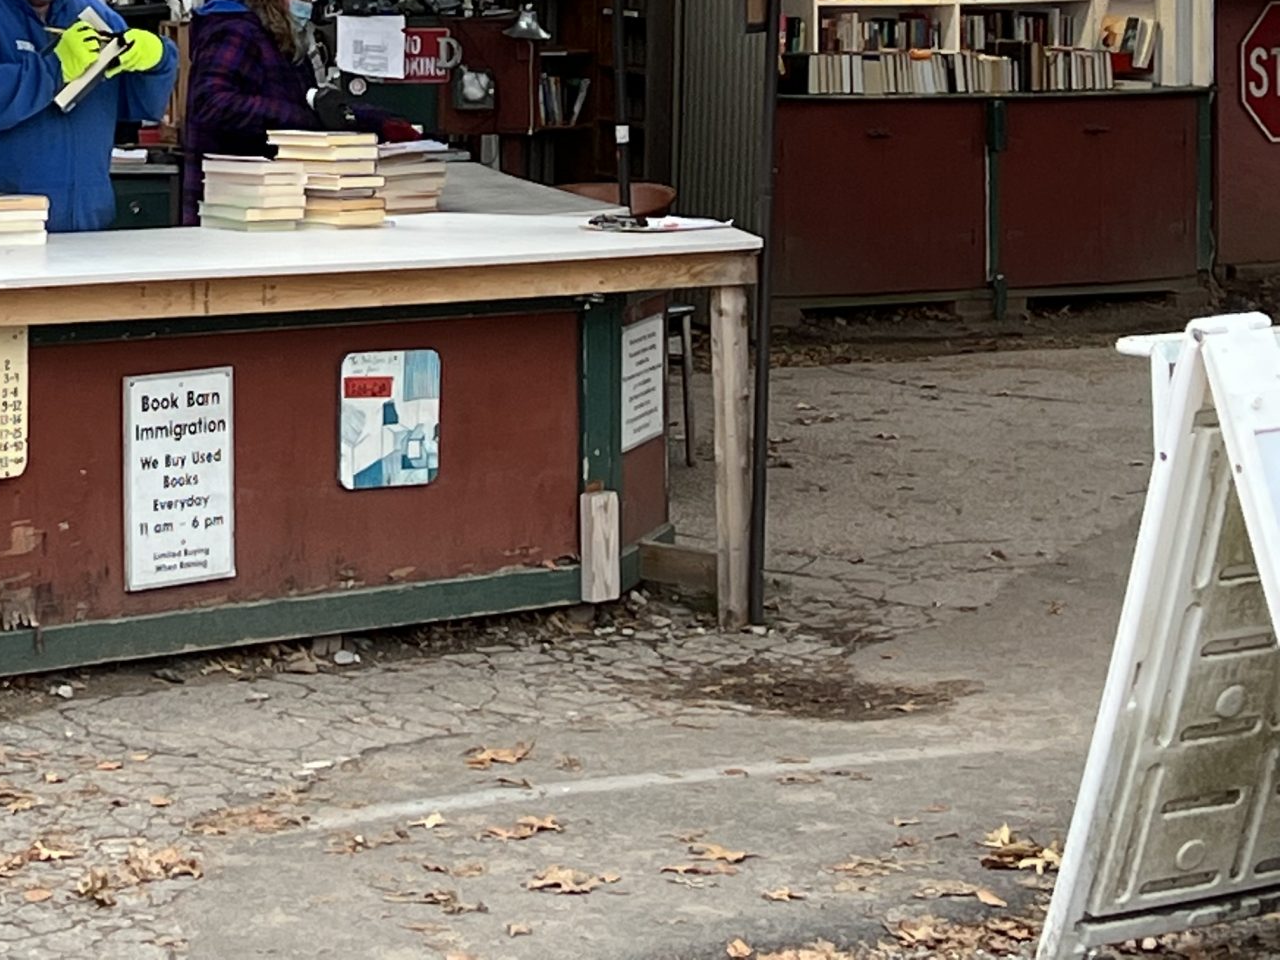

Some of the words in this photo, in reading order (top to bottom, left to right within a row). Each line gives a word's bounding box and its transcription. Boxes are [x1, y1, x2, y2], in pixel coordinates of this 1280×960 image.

[141, 391, 180, 413] Book
[186, 390, 221, 408] Barn
[135, 416, 227, 442] Immigration
[140, 455, 159, 471] We
[164, 453, 187, 469] Buy
[191, 447, 222, 466] Used
[163, 472, 200, 489] Books
[152, 494, 211, 512] Everyday
[139, 522, 149, 537] 11
[153, 522, 174, 534] am
[191, 515, 200, 529] 6
[204, 514, 225, 530] pm
